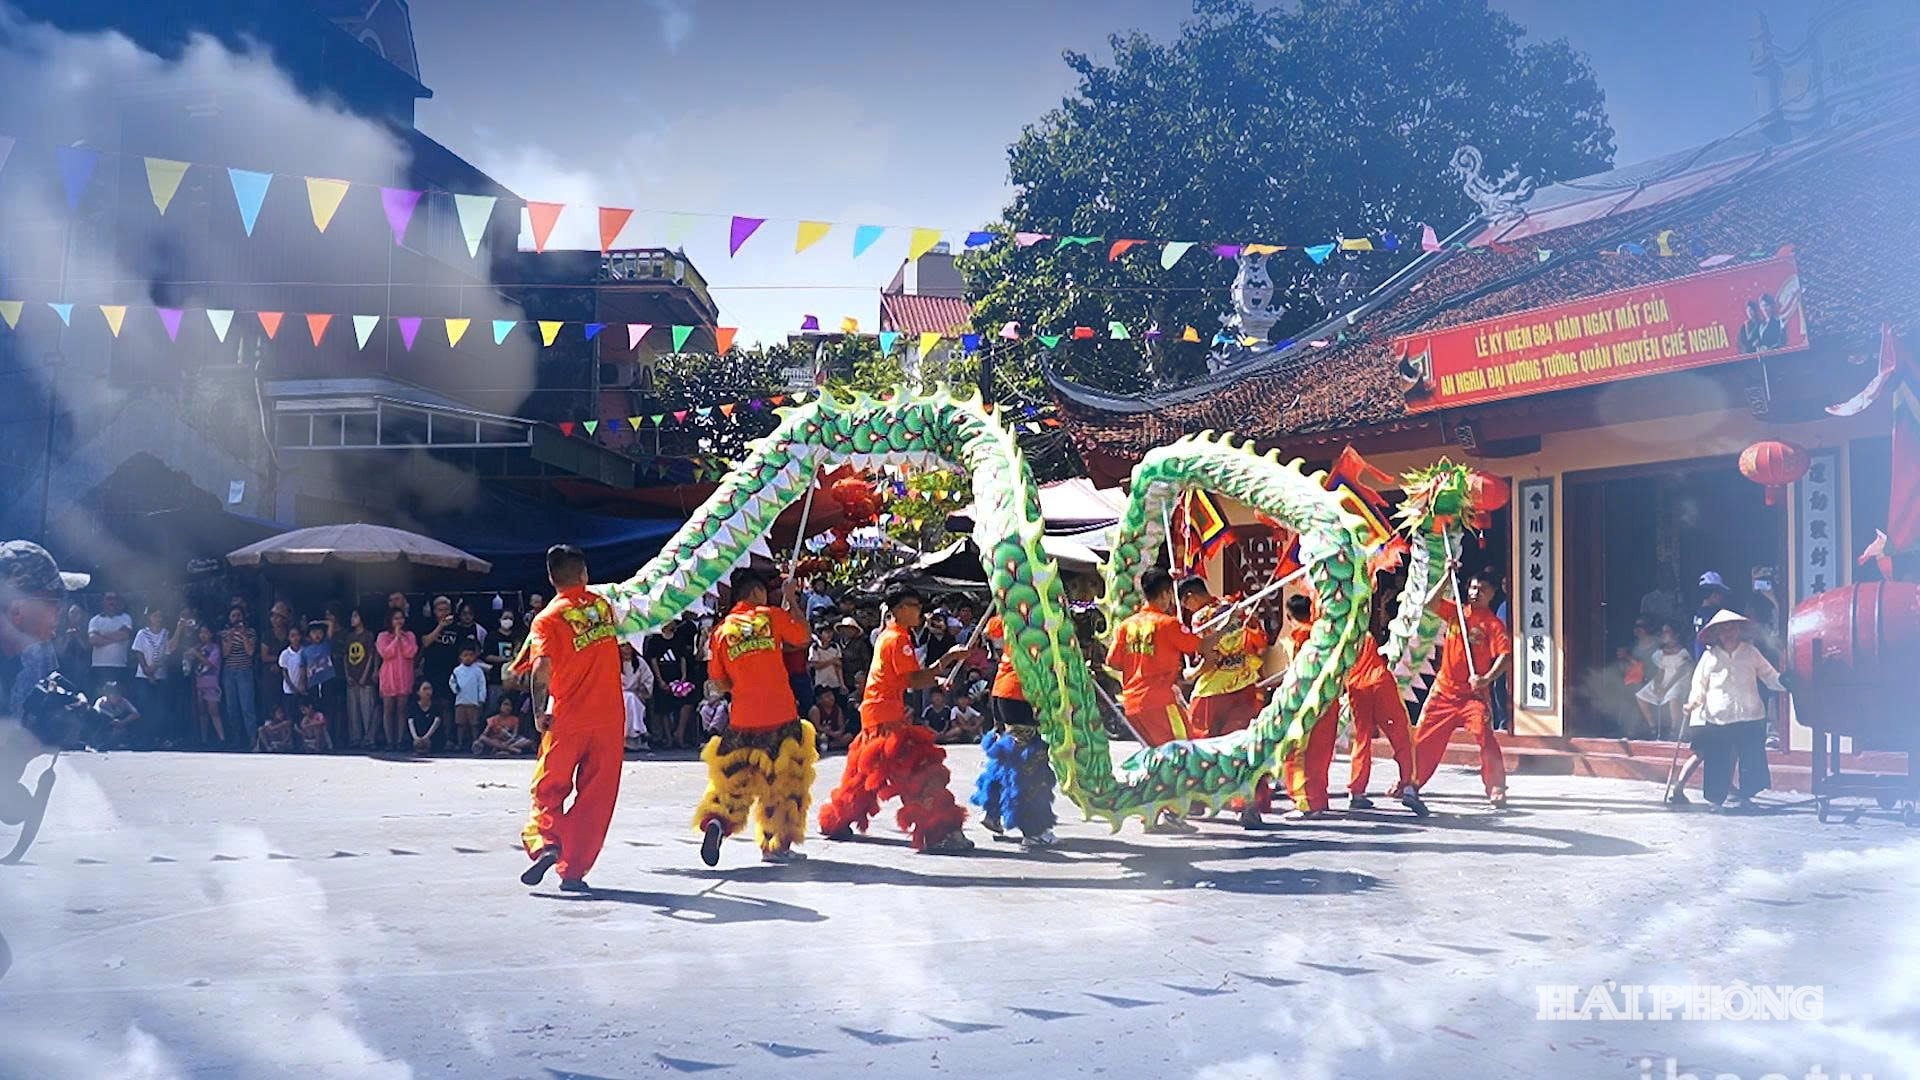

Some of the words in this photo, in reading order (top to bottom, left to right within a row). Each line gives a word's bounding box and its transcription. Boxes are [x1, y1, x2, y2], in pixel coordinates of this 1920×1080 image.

[1440, 375, 1455, 396] AN
[1456, 366, 1487, 394] NGHĨA
[1487, 364, 1505, 392] ĐẠI
[1505, 359, 1541, 385] VƯƠNG
[1579, 342, 1611, 373] QUÂN
[1612, 330, 1660, 366] NGUYỄN
[1662, 323, 1687, 358] CHẾ
[1688, 320, 1729, 353] NGHĨA
[1504, 324, 1532, 355] NIỆM
[1532, 323, 1552, 346] 684
[1554, 314, 1581, 342] NĂM
[1582, 307, 1613, 336] NGÀY
[1615, 296, 1640, 331] MẤT
[1643, 292, 1669, 325] CỦA
